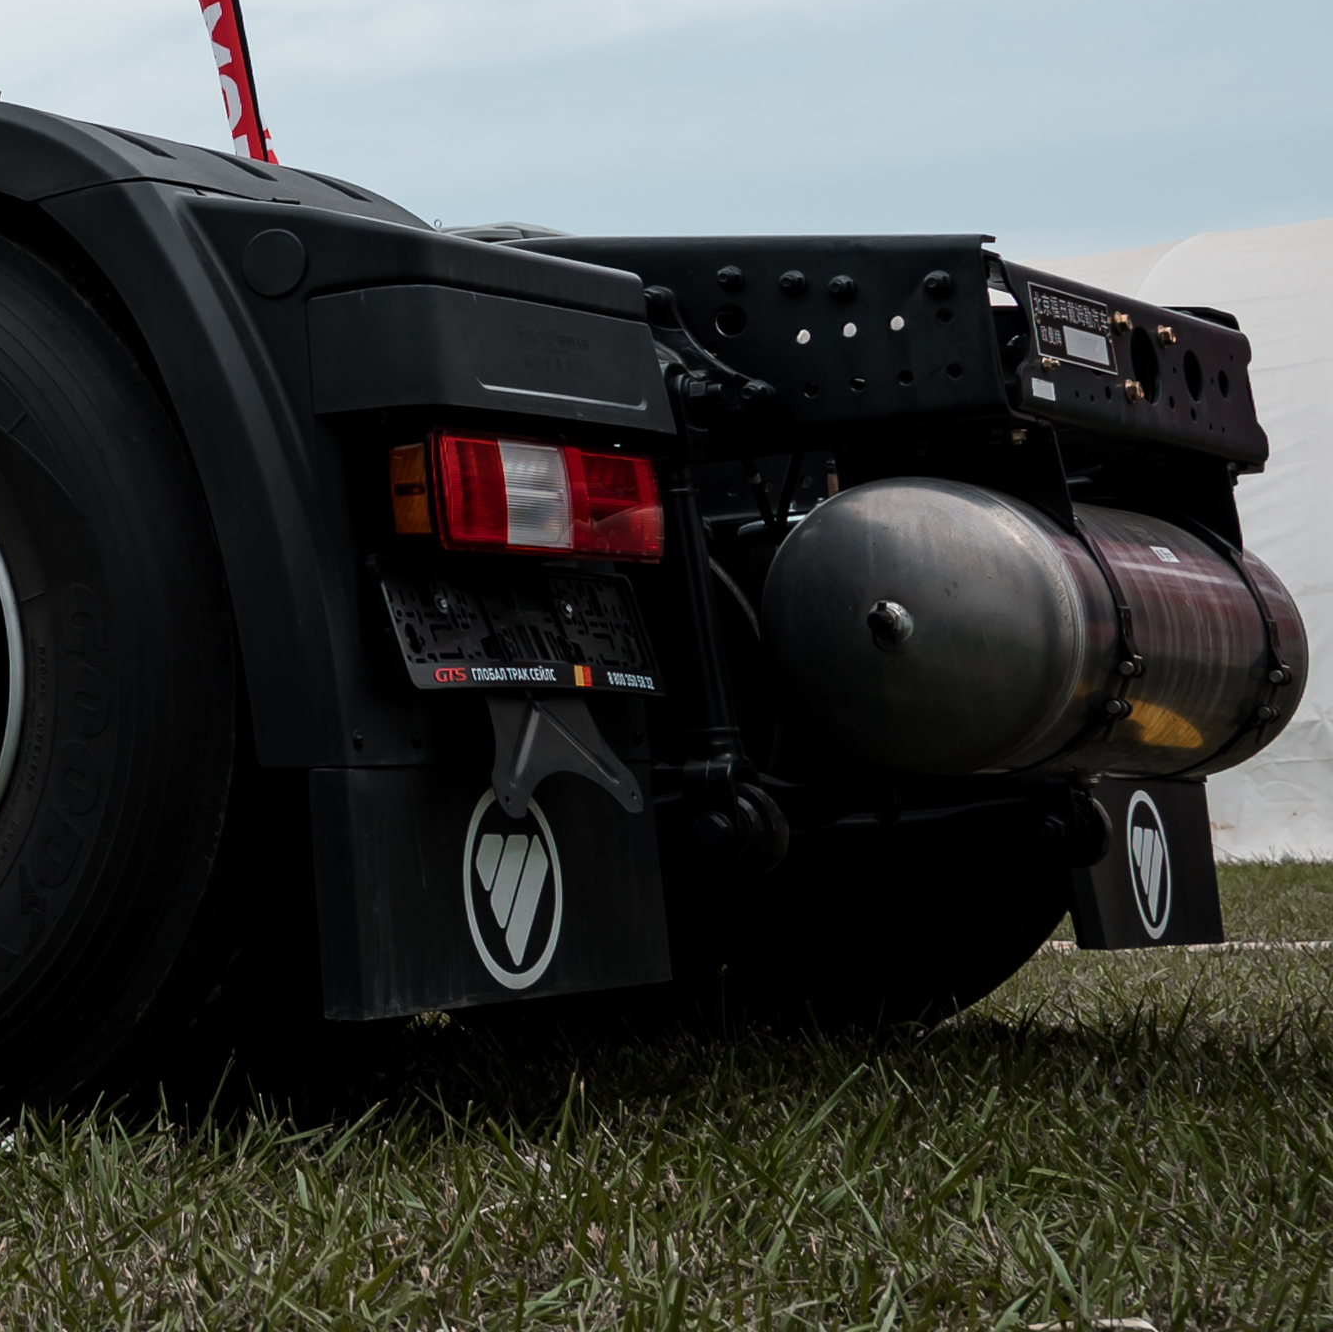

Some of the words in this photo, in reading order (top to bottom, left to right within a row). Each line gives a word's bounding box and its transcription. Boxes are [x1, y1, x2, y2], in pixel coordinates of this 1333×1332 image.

[38, 645, 46, 698] RADIAL
[434, 666, 467, 683] GTS
[471, 667, 508, 682] ГЛОБАЛ
[508, 667, 531, 682] ТРАК
[531, 665, 558, 683] СЕЙЛС
